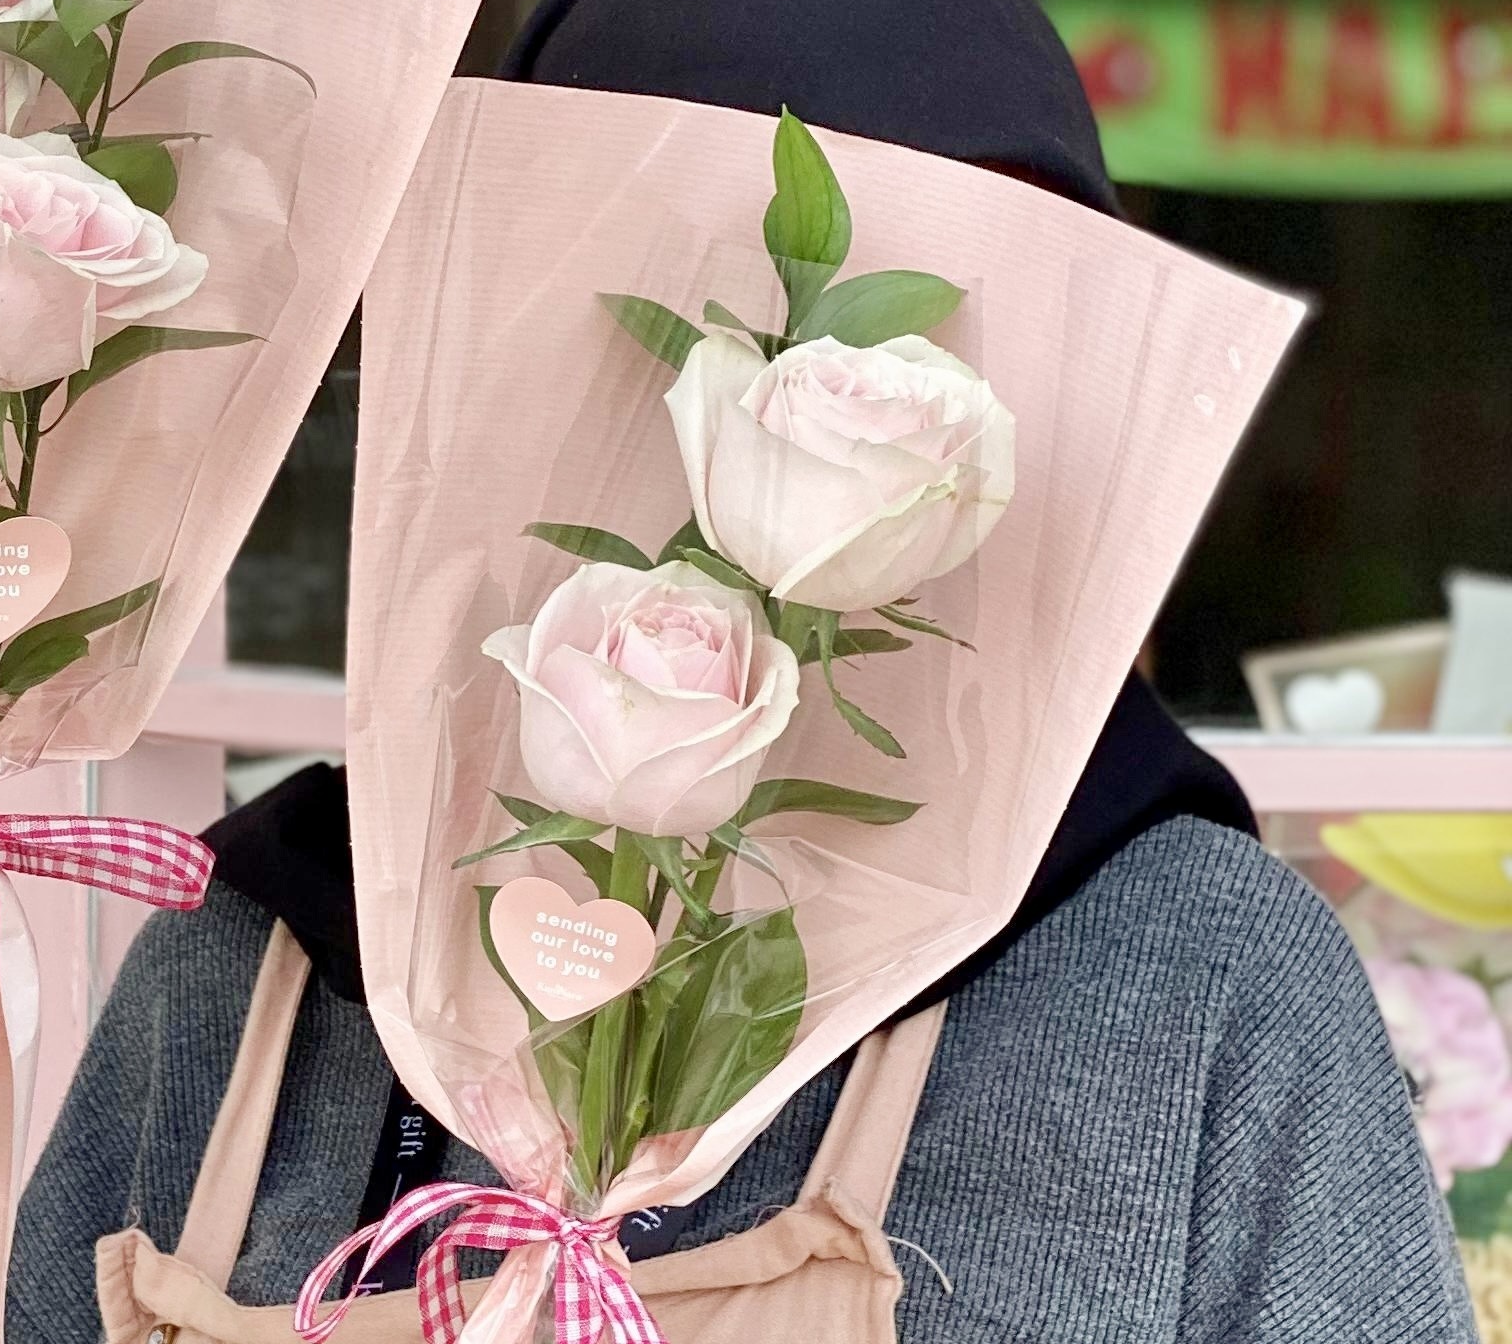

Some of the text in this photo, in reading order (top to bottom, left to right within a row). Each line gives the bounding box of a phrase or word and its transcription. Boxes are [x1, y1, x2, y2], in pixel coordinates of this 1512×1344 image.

[535, 911, 618, 947] sending
[530, 930, 616, 963] our love
[535, 950, 601, 980] to you
[397, 1115, 427, 1158] gift
